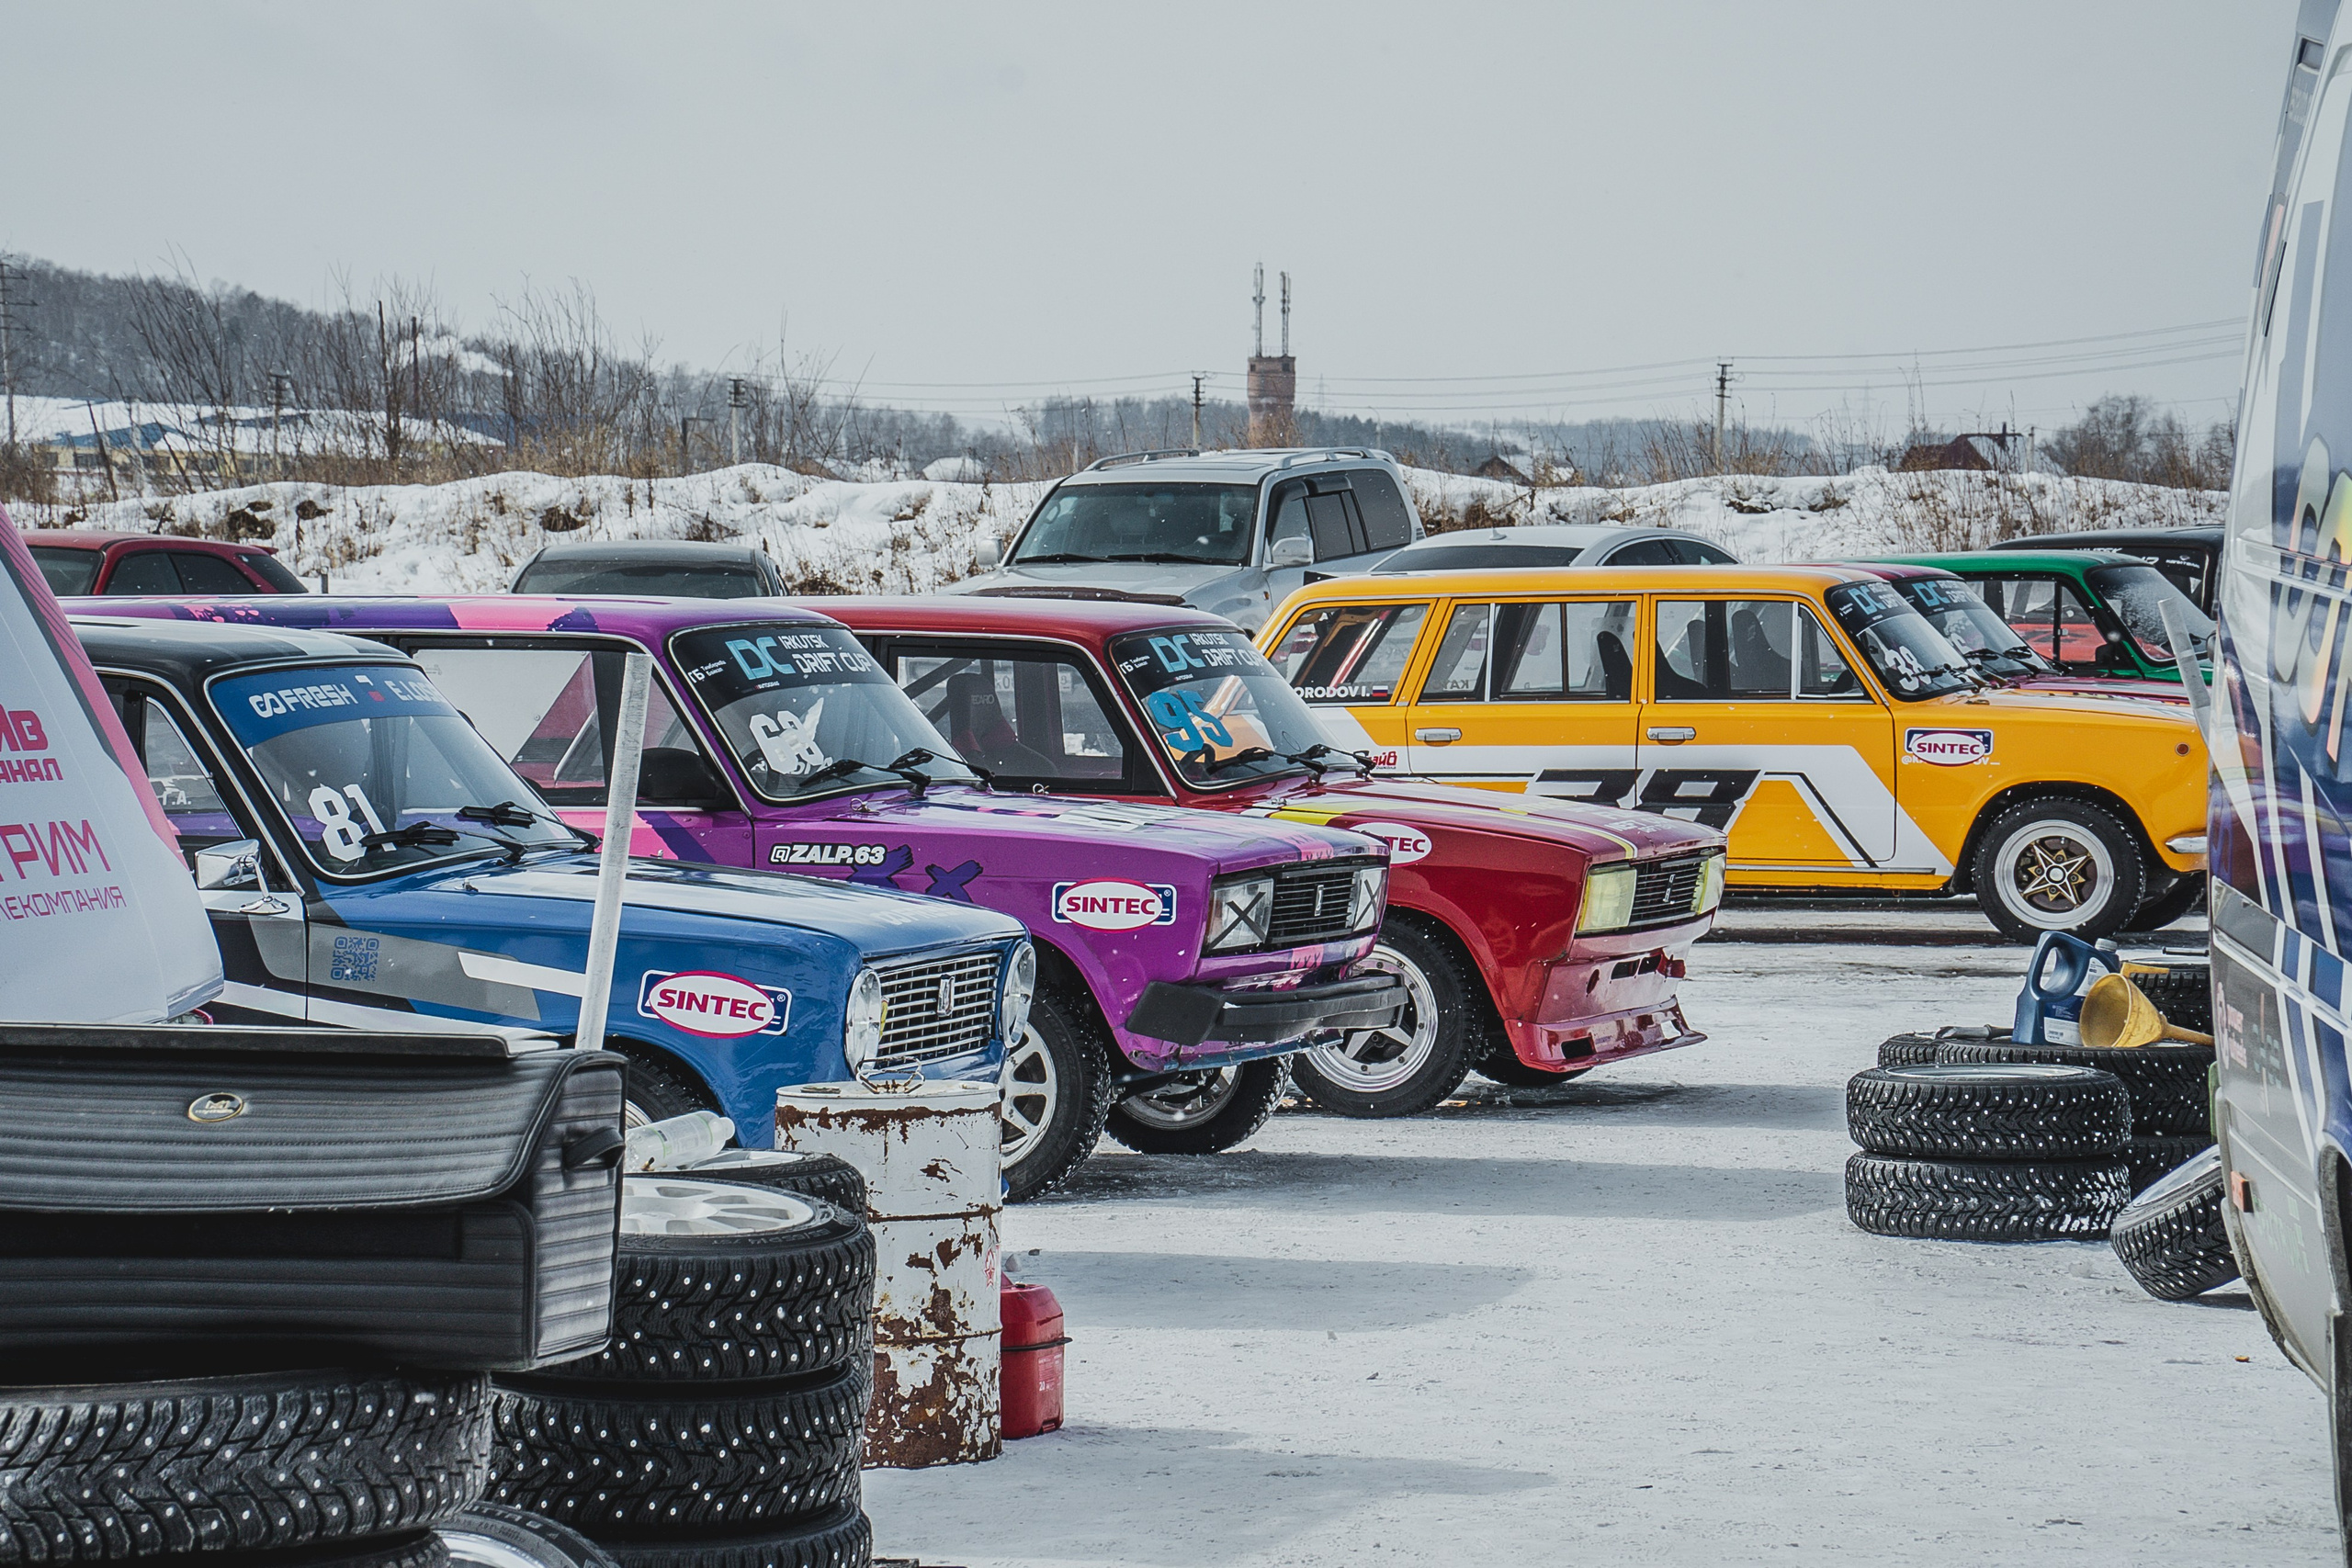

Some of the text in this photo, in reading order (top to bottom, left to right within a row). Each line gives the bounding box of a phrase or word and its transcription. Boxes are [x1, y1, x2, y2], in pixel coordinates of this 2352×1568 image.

[1848, 584, 1887, 615] DC
[1912, 581, 1951, 607] DC
[777, 634, 830, 649] IRKUTSK
[1148, 634, 1207, 673] DC
[725, 636, 797, 681] DC
[791, 651, 873, 674] DRIFT CUP
[1202, 648, 1264, 668] DRIFT CUP
[1148, 690, 1233, 752] 95
[1917, 742, 1980, 755] SINTEC
[308, 783, 397, 863] 81
[0, 819, 111, 883] РИМ
[770, 844, 886, 865] @ZALP.63
[1384, 836, 1426, 853] TEC
[1066, 896, 1156, 916] SINTEC
[657, 987, 767, 1022] SINTEC
